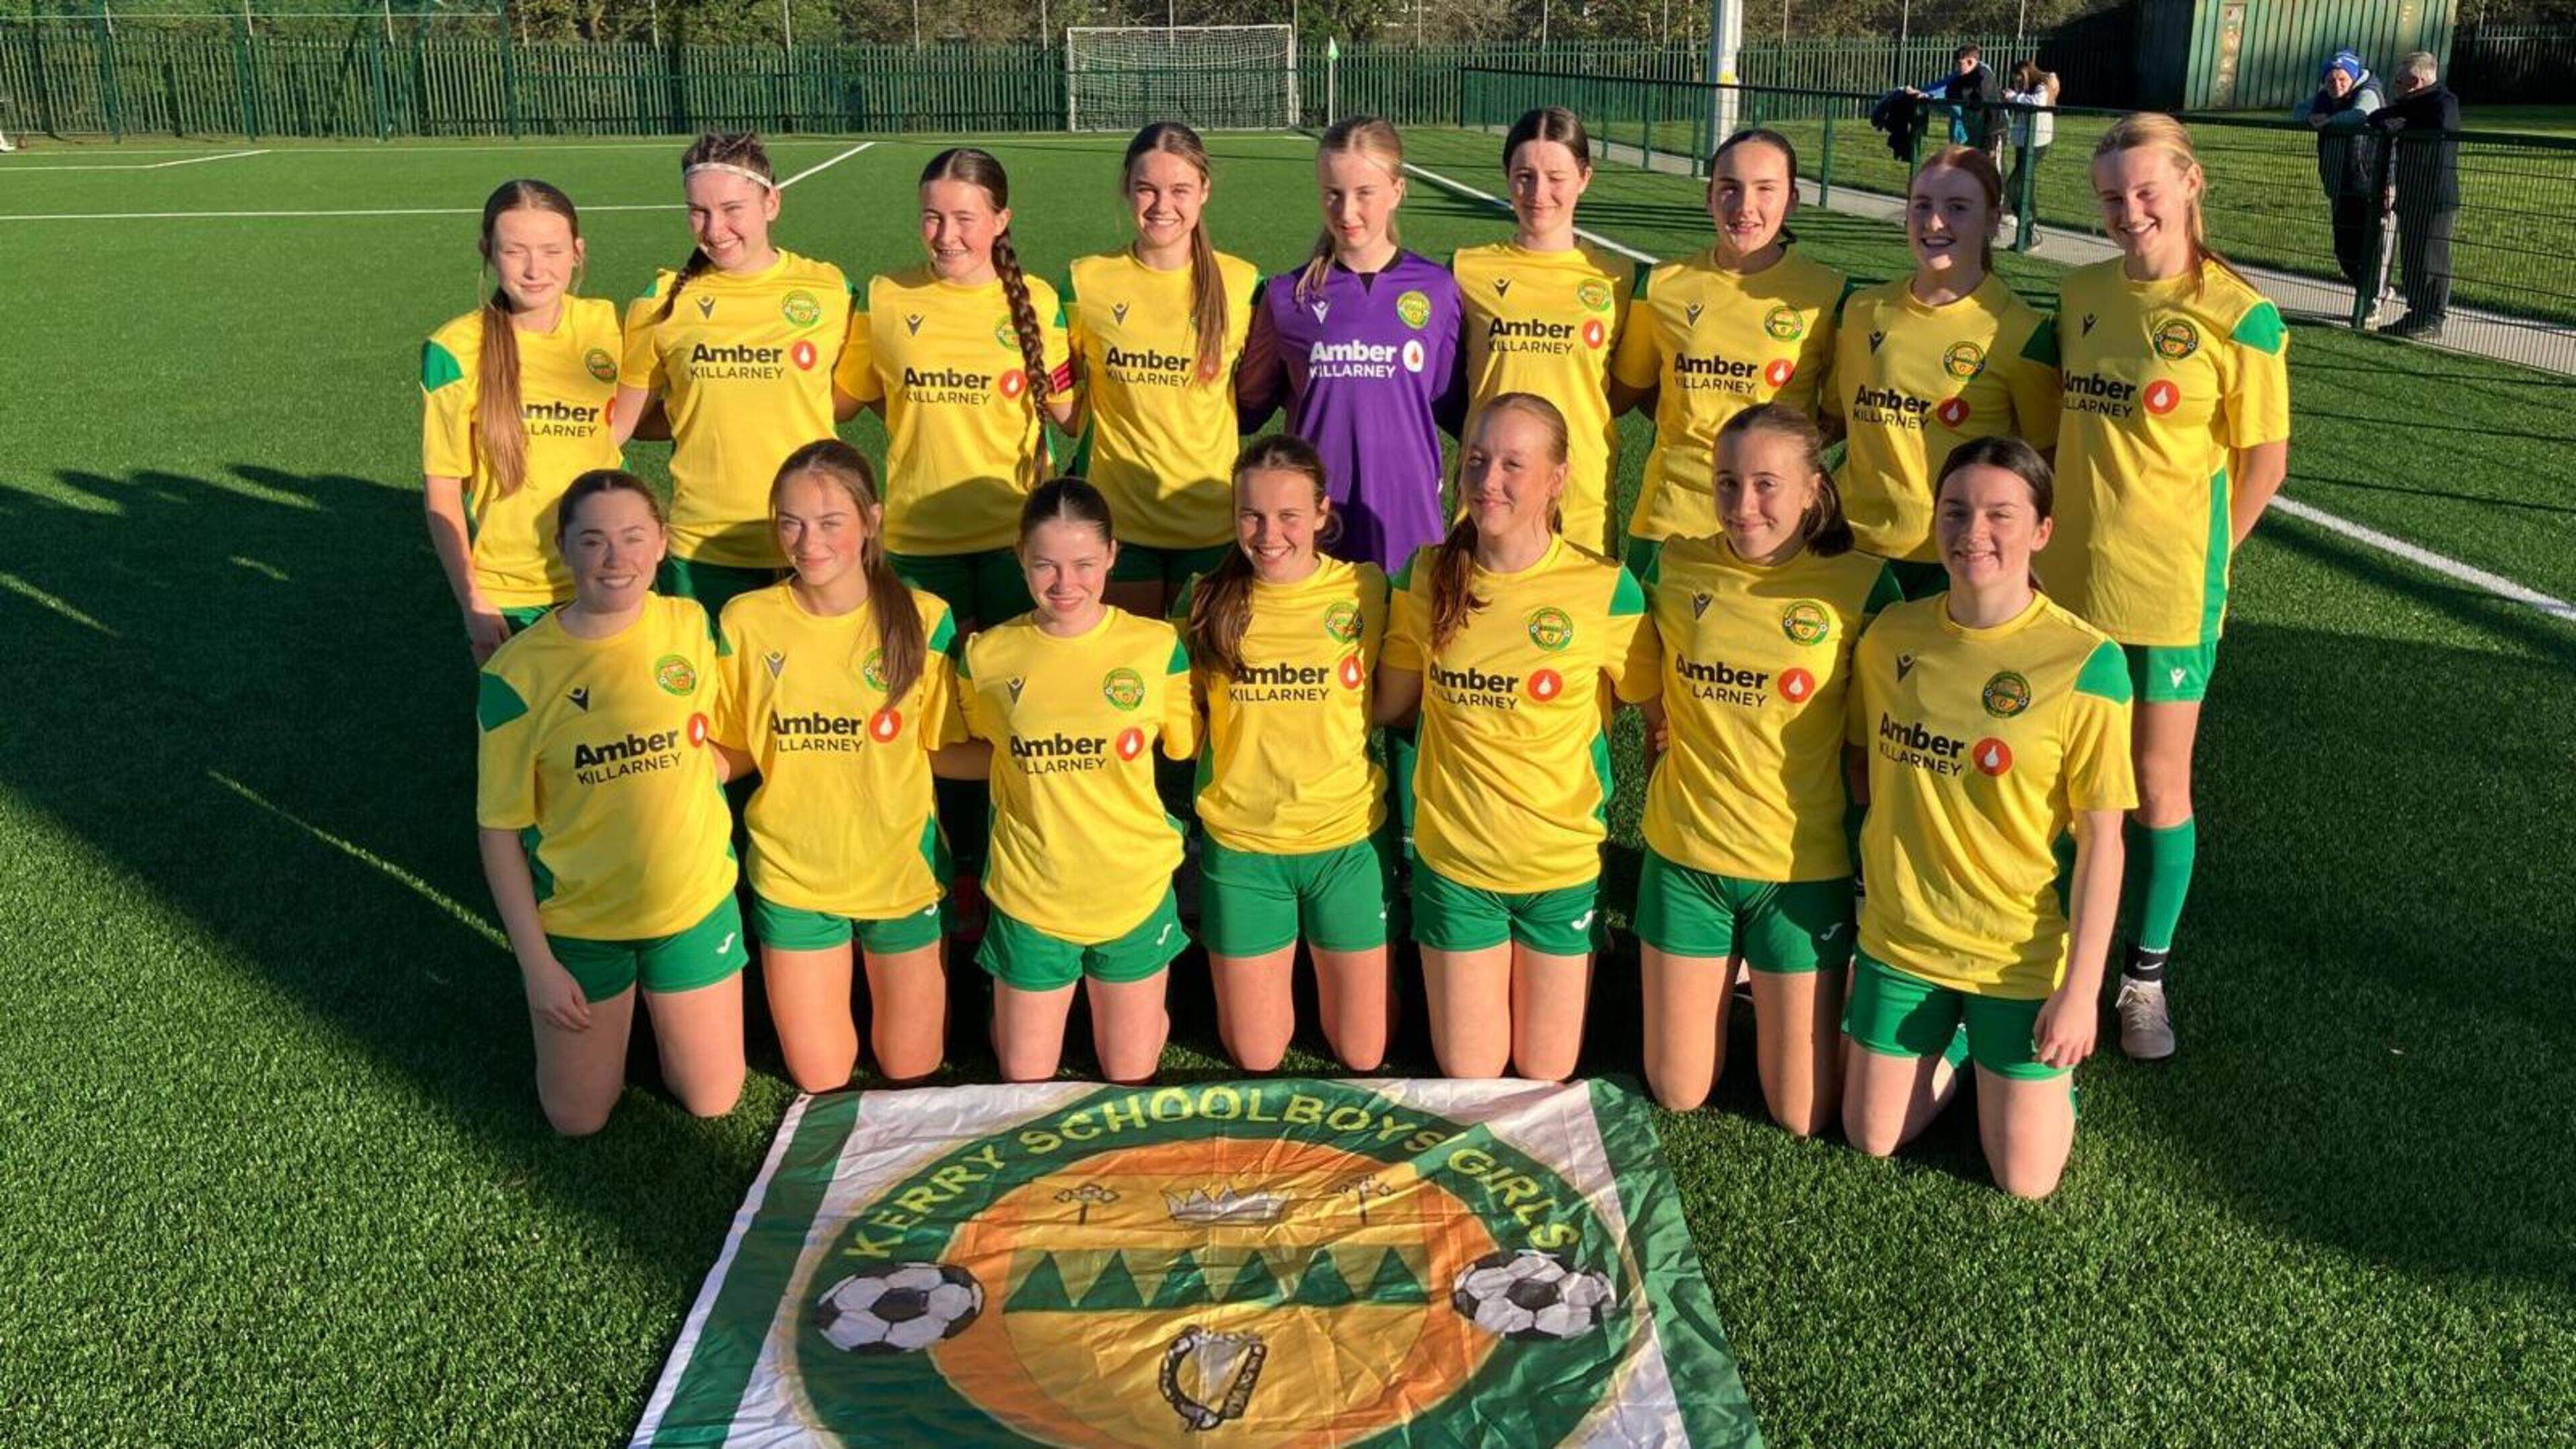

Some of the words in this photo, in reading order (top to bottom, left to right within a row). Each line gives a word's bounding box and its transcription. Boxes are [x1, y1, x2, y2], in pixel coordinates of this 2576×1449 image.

[1489, 317, 1575, 339] Amber
[691, 343, 783, 363] Amber
[1309, 339, 1397, 363] Amber
[1489, 339, 1573, 355] KILLARNEY
[1106, 347, 1191, 372] Amber
[1309, 364, 1396, 378] KILLARNEY
[1674, 352, 1758, 378] Amber
[690, 367, 784, 379] KILLARNEY
[904, 367, 992, 390] Amber
[905, 390, 991, 405] KILLARNEY
[1854, 384, 1931, 415] Amber
[2063, 397, 2133, 418] LARNEY
[523, 400, 599, 423] mber
[1853, 409, 1929, 430] KILLARNEY
[527, 423, 597, 437] LARNEY
[1230, 662, 1330, 685] Amber
[1429, 661, 1519, 693] Amber
[1676, 653, 1769, 690] Amber
[1229, 688, 1330, 702] KILLARNEY
[1692, 683, 1768, 708] LARNEY
[771, 710, 862, 736] Amber
[773, 737, 863, 753] ILLARNEY
[1010, 732, 1107, 757] Amber
[1880, 711, 1966, 759] Amber
[574, 729, 680, 769] Amber
[577, 752, 682, 786] KILLARNEY
[843, 1143, 1006, 1260] KERRY
[1018, 1086, 1446, 1155] SCHOOLBOYS
[1448, 1148, 1580, 1249] GIRLS
